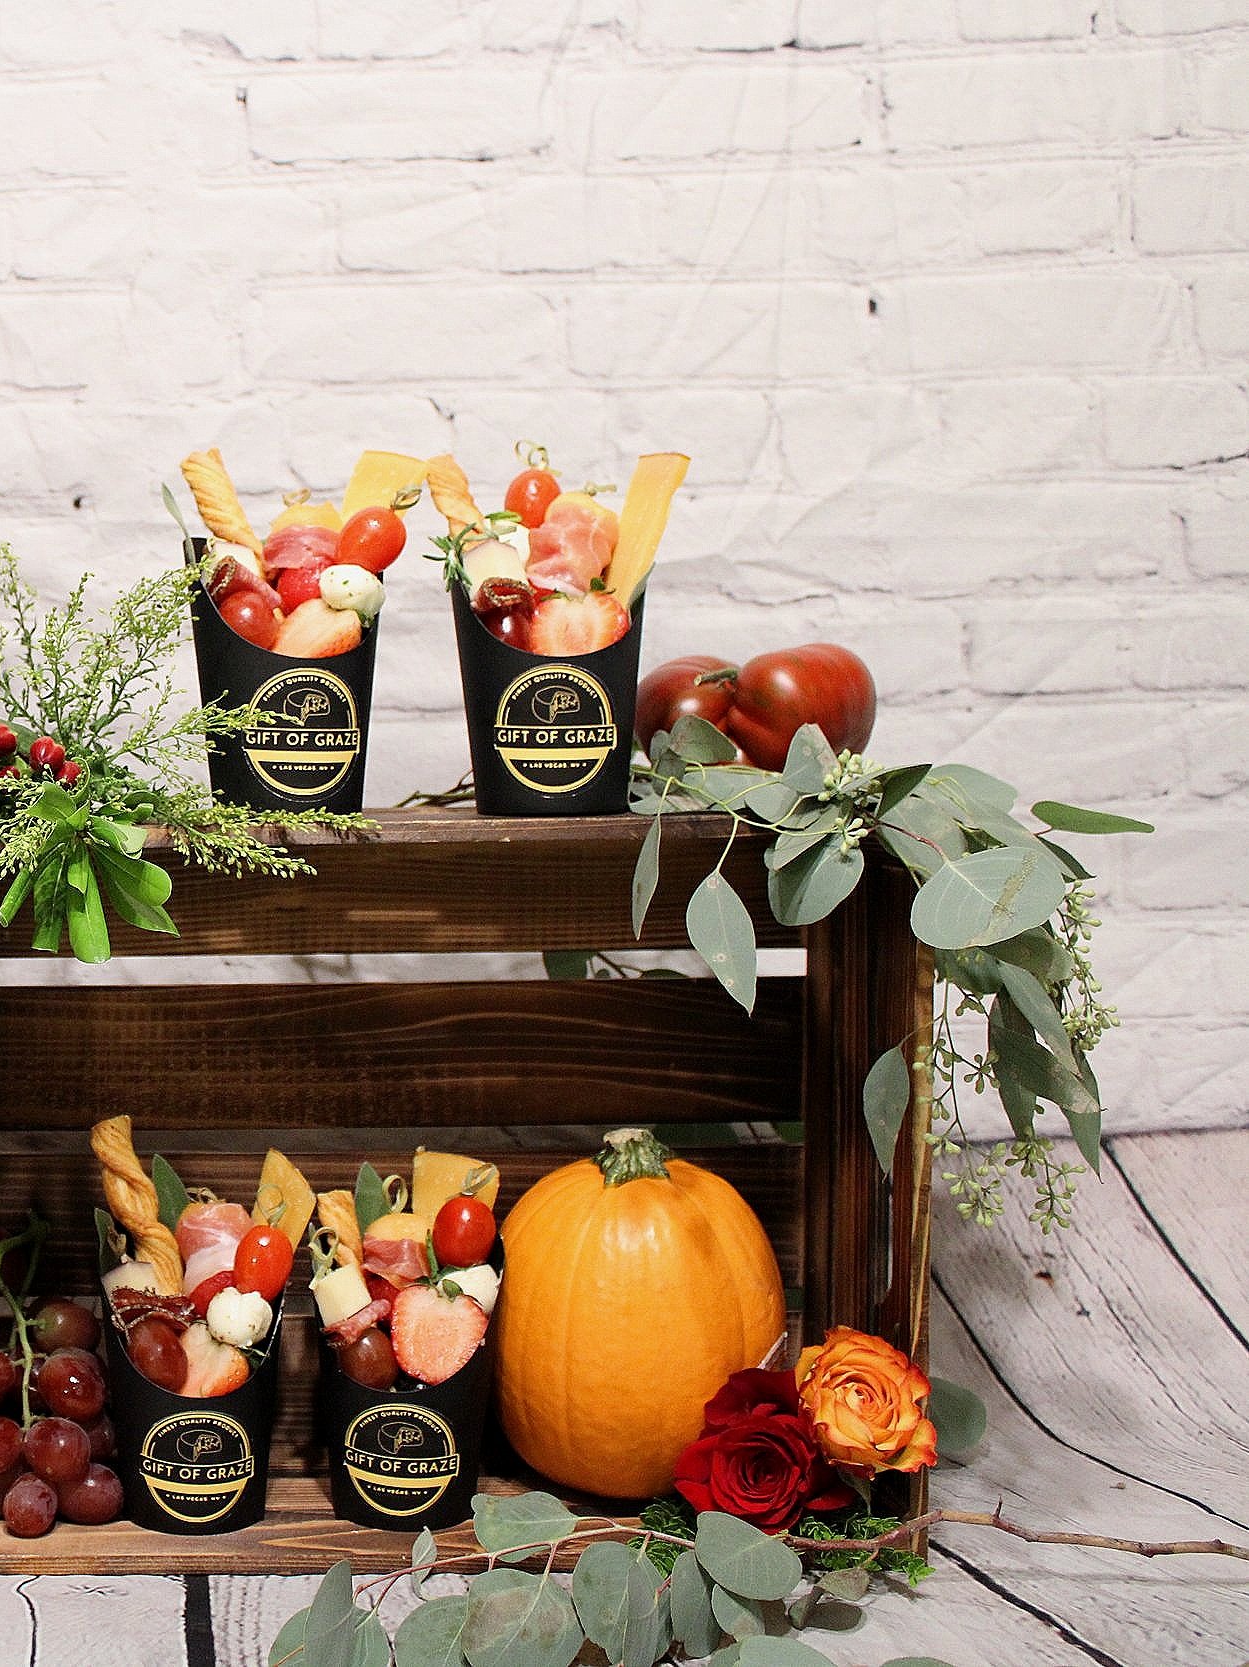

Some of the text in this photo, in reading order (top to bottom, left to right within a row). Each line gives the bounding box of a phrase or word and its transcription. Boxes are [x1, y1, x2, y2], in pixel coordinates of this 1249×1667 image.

[246, 732, 358, 746] GIFT OF GRAZE
[498, 729, 613, 744] GIFT OF GRAZE
[143, 1460, 251, 1479] GIFT OF GRAZE
[345, 1450, 457, 1474] GIFT OF GRAZE
